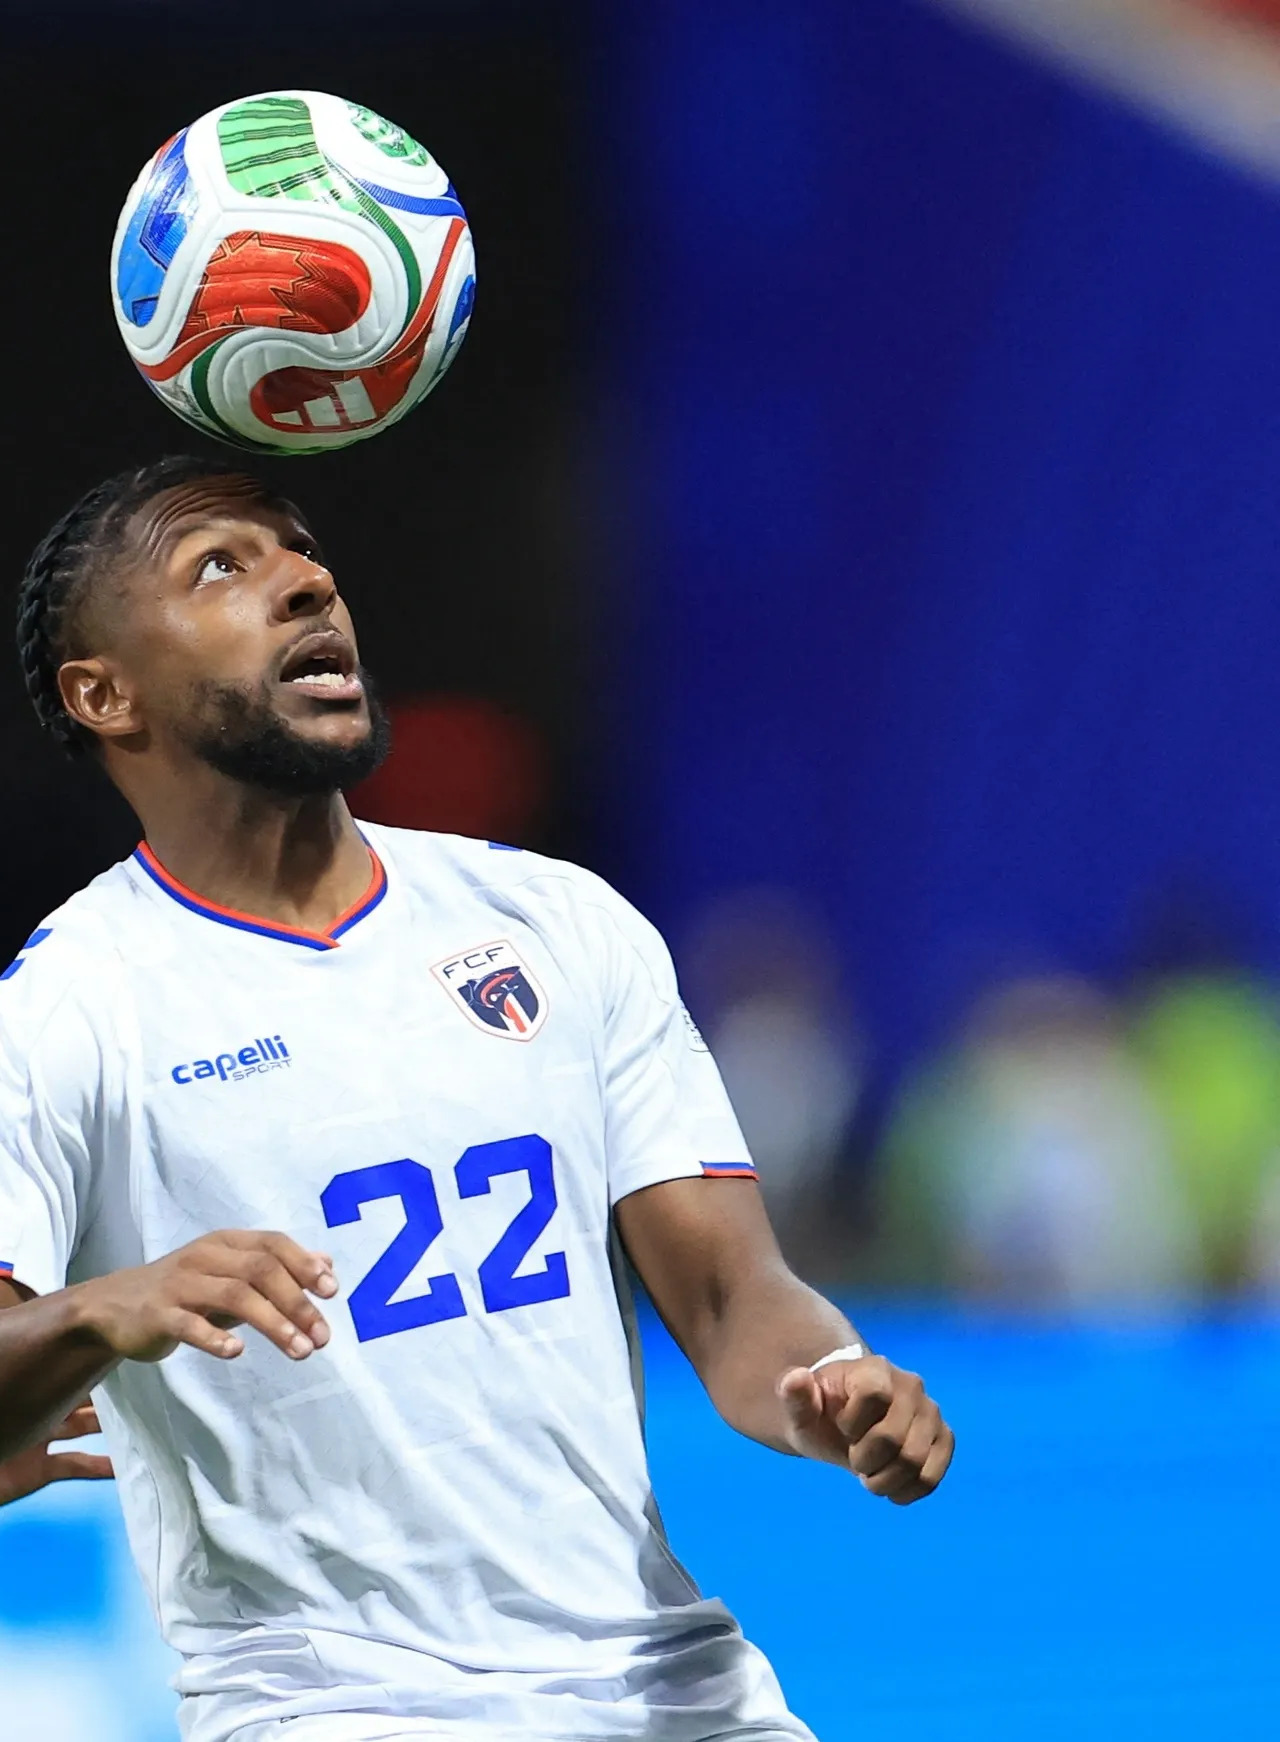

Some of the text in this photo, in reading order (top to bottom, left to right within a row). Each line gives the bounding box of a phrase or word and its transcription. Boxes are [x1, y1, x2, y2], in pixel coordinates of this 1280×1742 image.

[442, 946, 504, 979] FCF
[171, 1035, 290, 1085] capelli
[232, 1057, 293, 1082] SPORT
[320, 1133, 571, 1343] 22
